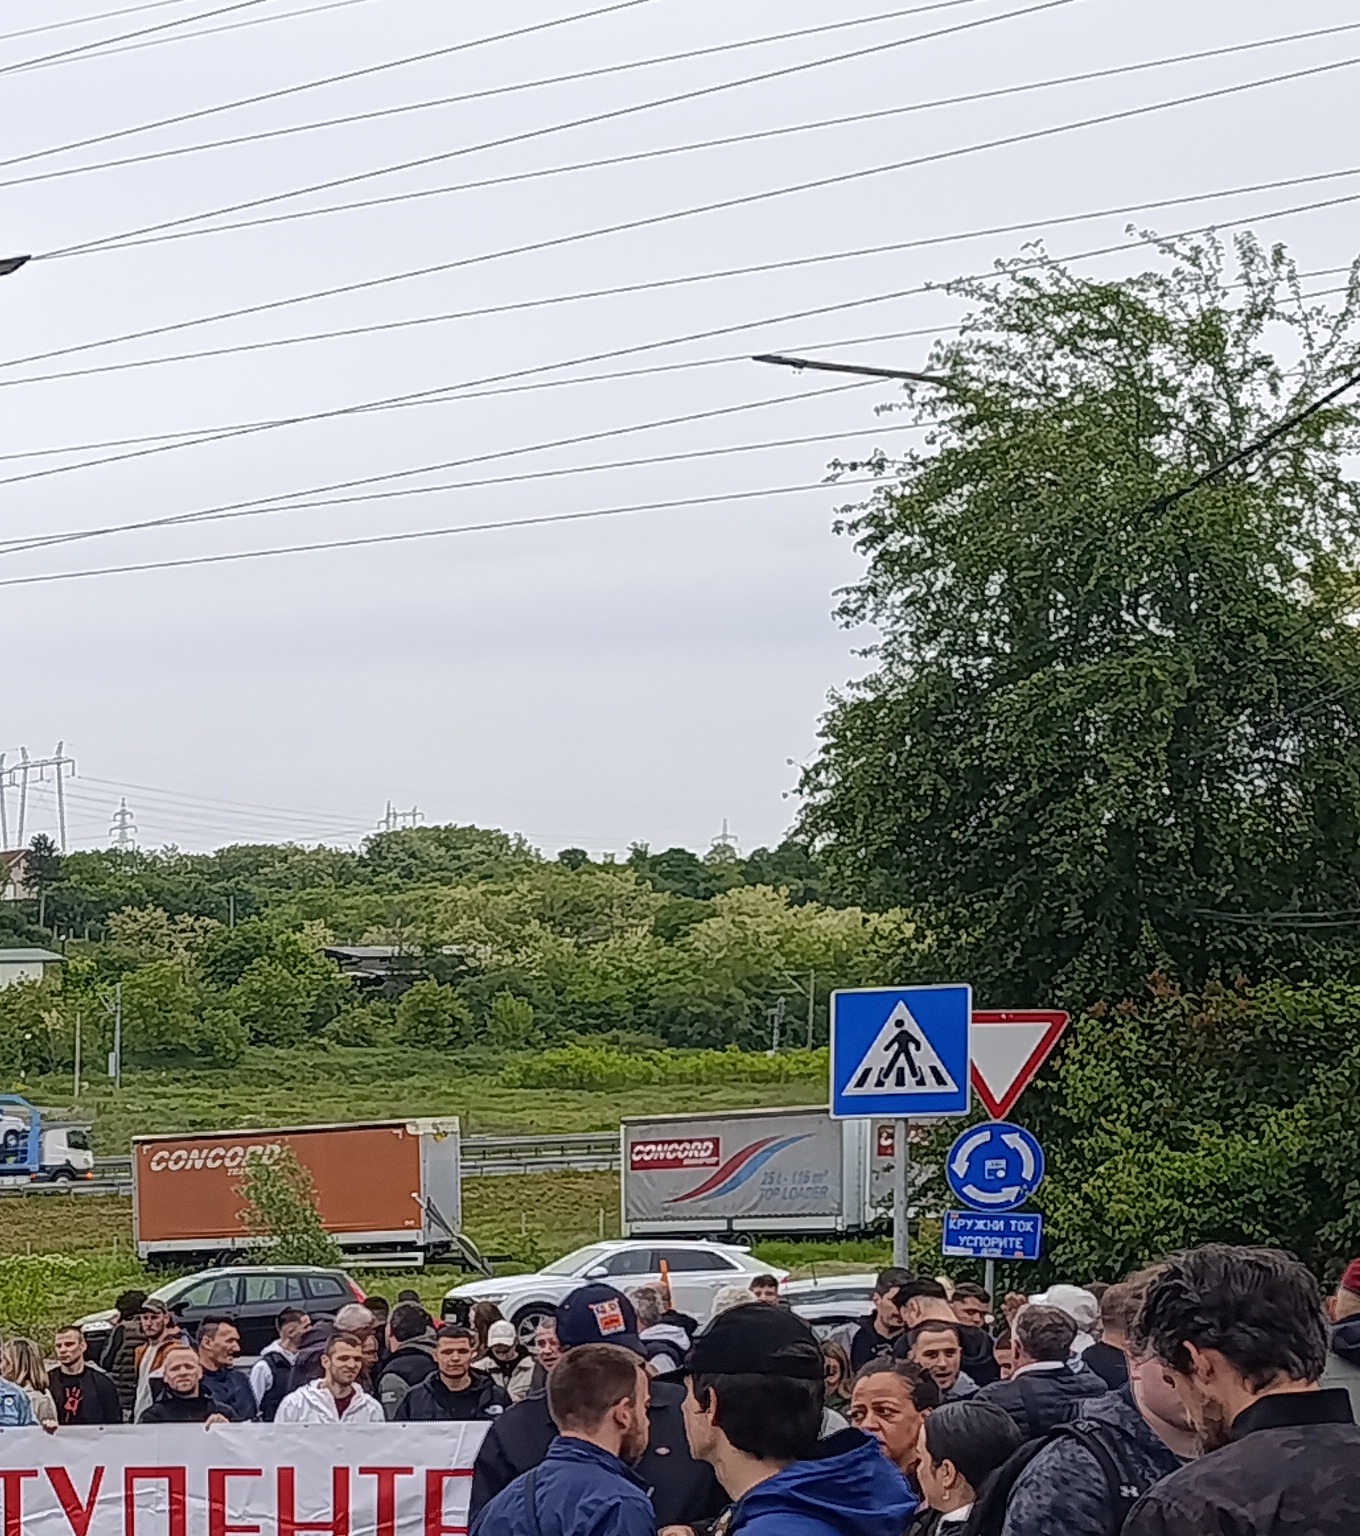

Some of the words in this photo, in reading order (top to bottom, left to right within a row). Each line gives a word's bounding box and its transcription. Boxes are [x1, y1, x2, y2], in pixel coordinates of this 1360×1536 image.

[631, 1141, 714, 1161] CONCORD
[948, 1218, 1004, 1232] КРУЖНИ
[1010, 1220, 1034, 1232] ТОК
[958, 1235, 1024, 1249] УСПОРИТЕ
